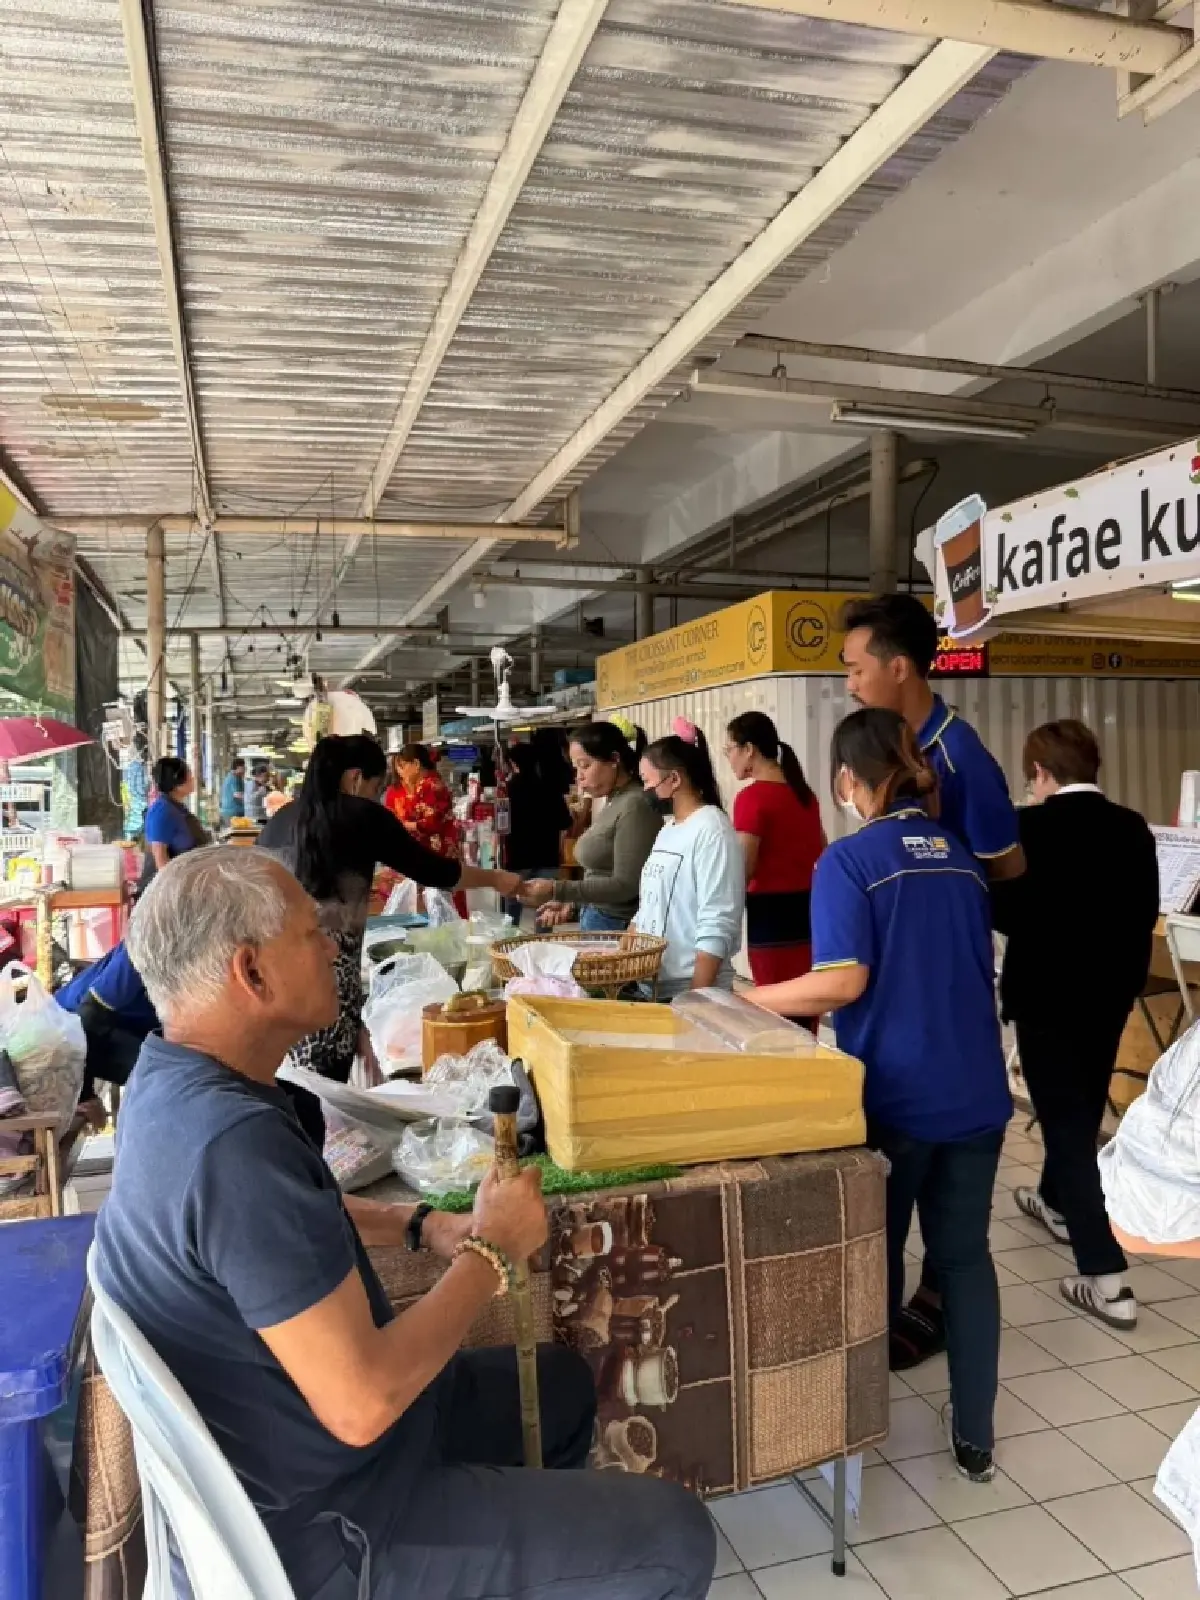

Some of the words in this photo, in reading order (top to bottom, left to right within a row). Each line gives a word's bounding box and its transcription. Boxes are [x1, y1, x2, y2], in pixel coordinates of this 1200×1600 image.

[997, 513, 1122, 593] kafae
[682, 619, 719, 648] CORNER
[936, 652, 982, 670] OPEN
